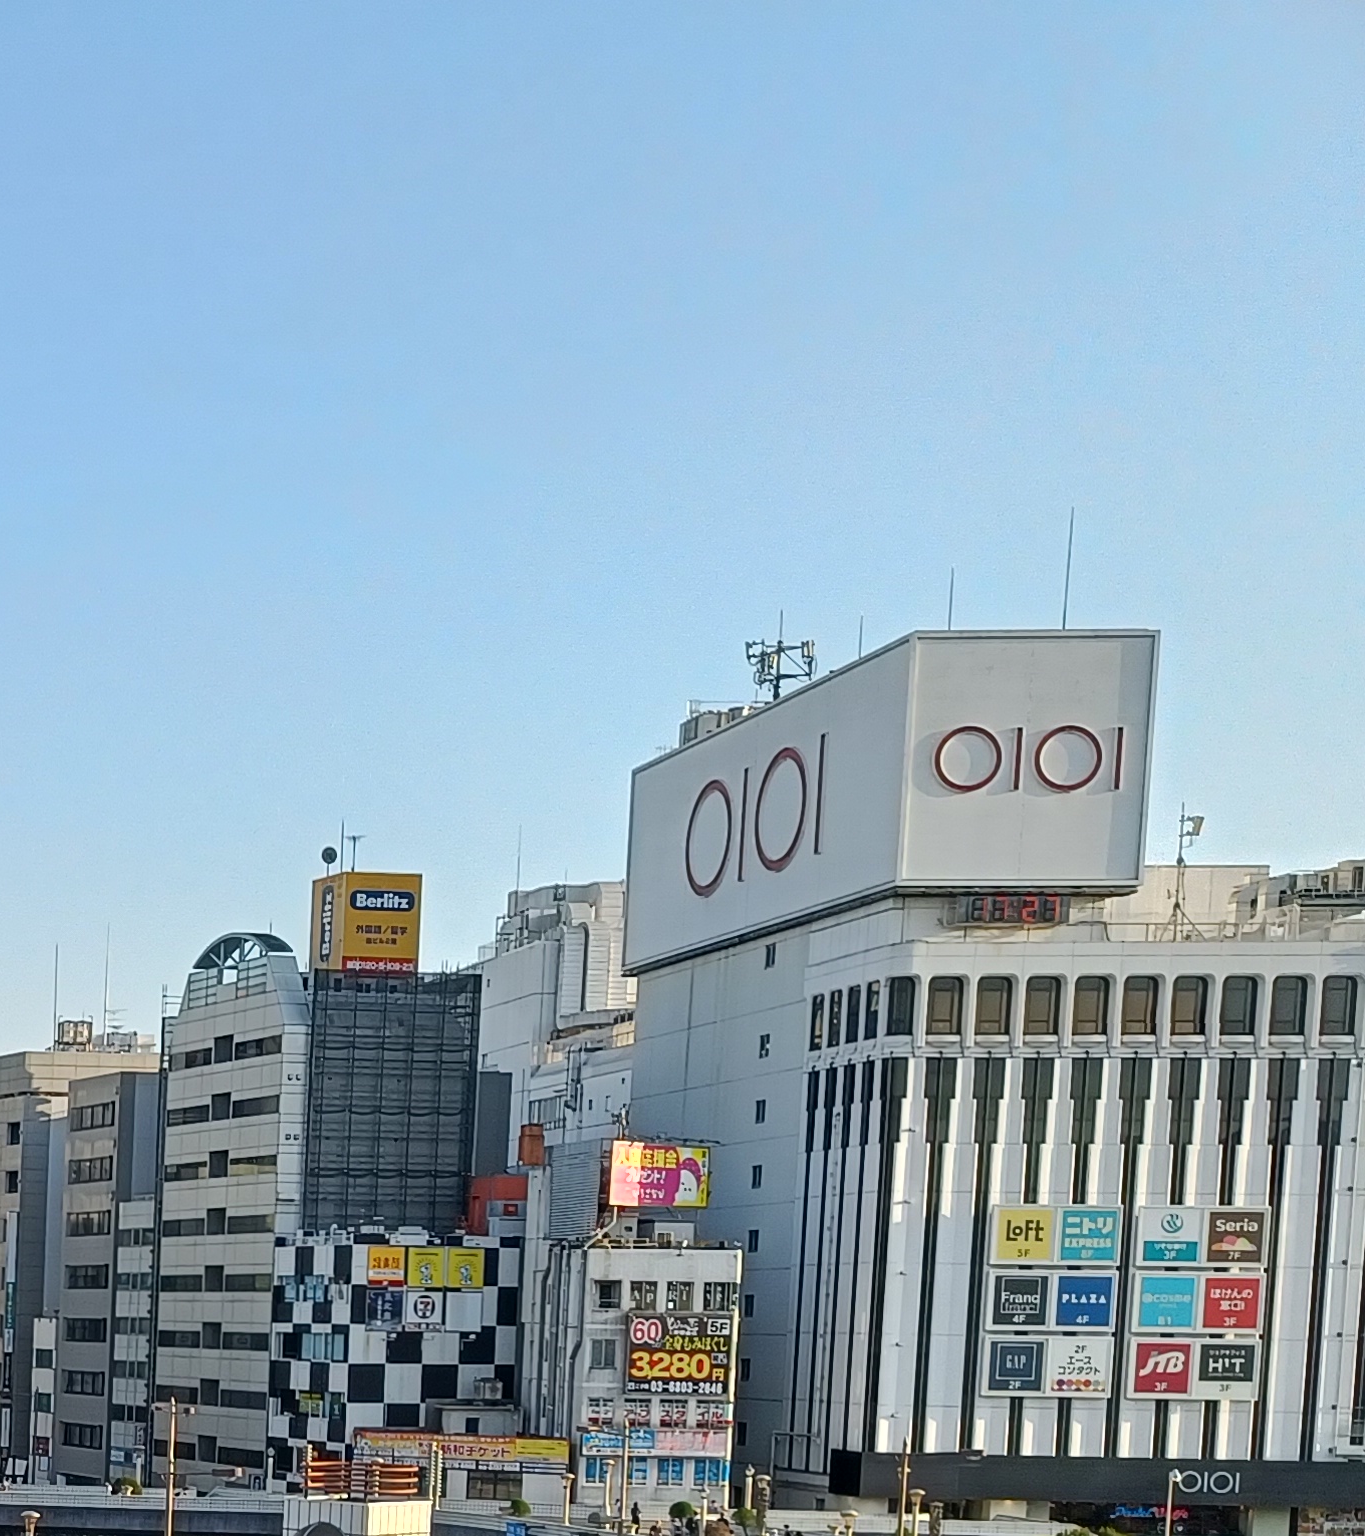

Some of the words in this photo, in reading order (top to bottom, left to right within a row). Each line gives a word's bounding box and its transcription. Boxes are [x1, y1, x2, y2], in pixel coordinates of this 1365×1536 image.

[355, 893, 409, 909] Berlitz
[322, 891, 333, 956] Berlitz
[1065, 1217, 1114, 1234] ニトリ
[1215, 1218, 1259, 1232] Seria
[1064, 1238, 1112, 1248] EXPRESS
[1017, 1249, 1031, 1258] 5F
[1162, 1251, 1177, 1260] 3F
[1001, 1292, 1040, 1303] Franc
[1061, 1293, 1107, 1304] PLAZA
[1210, 1288, 1254, 1299] ほけんの
[1012, 1315, 1026, 1324] 4F
[1075, 1315, 1090, 1324] 4F
[1223, 1317, 1238, 1327] 3F
[710, 1321, 729, 1333] 5F
[1074, 1345, 1087, 1353] 2F
[1006, 1355, 1027, 1369] GAP
[1066, 1356, 1092, 1365] エース
[1139, 1351, 1186, 1377] JTB
[1058, 1366, 1101, 1375] コンタクト
[1008, 1381, 1022, 1390] 2F
[1154, 1382, 1168, 1392] 3F
